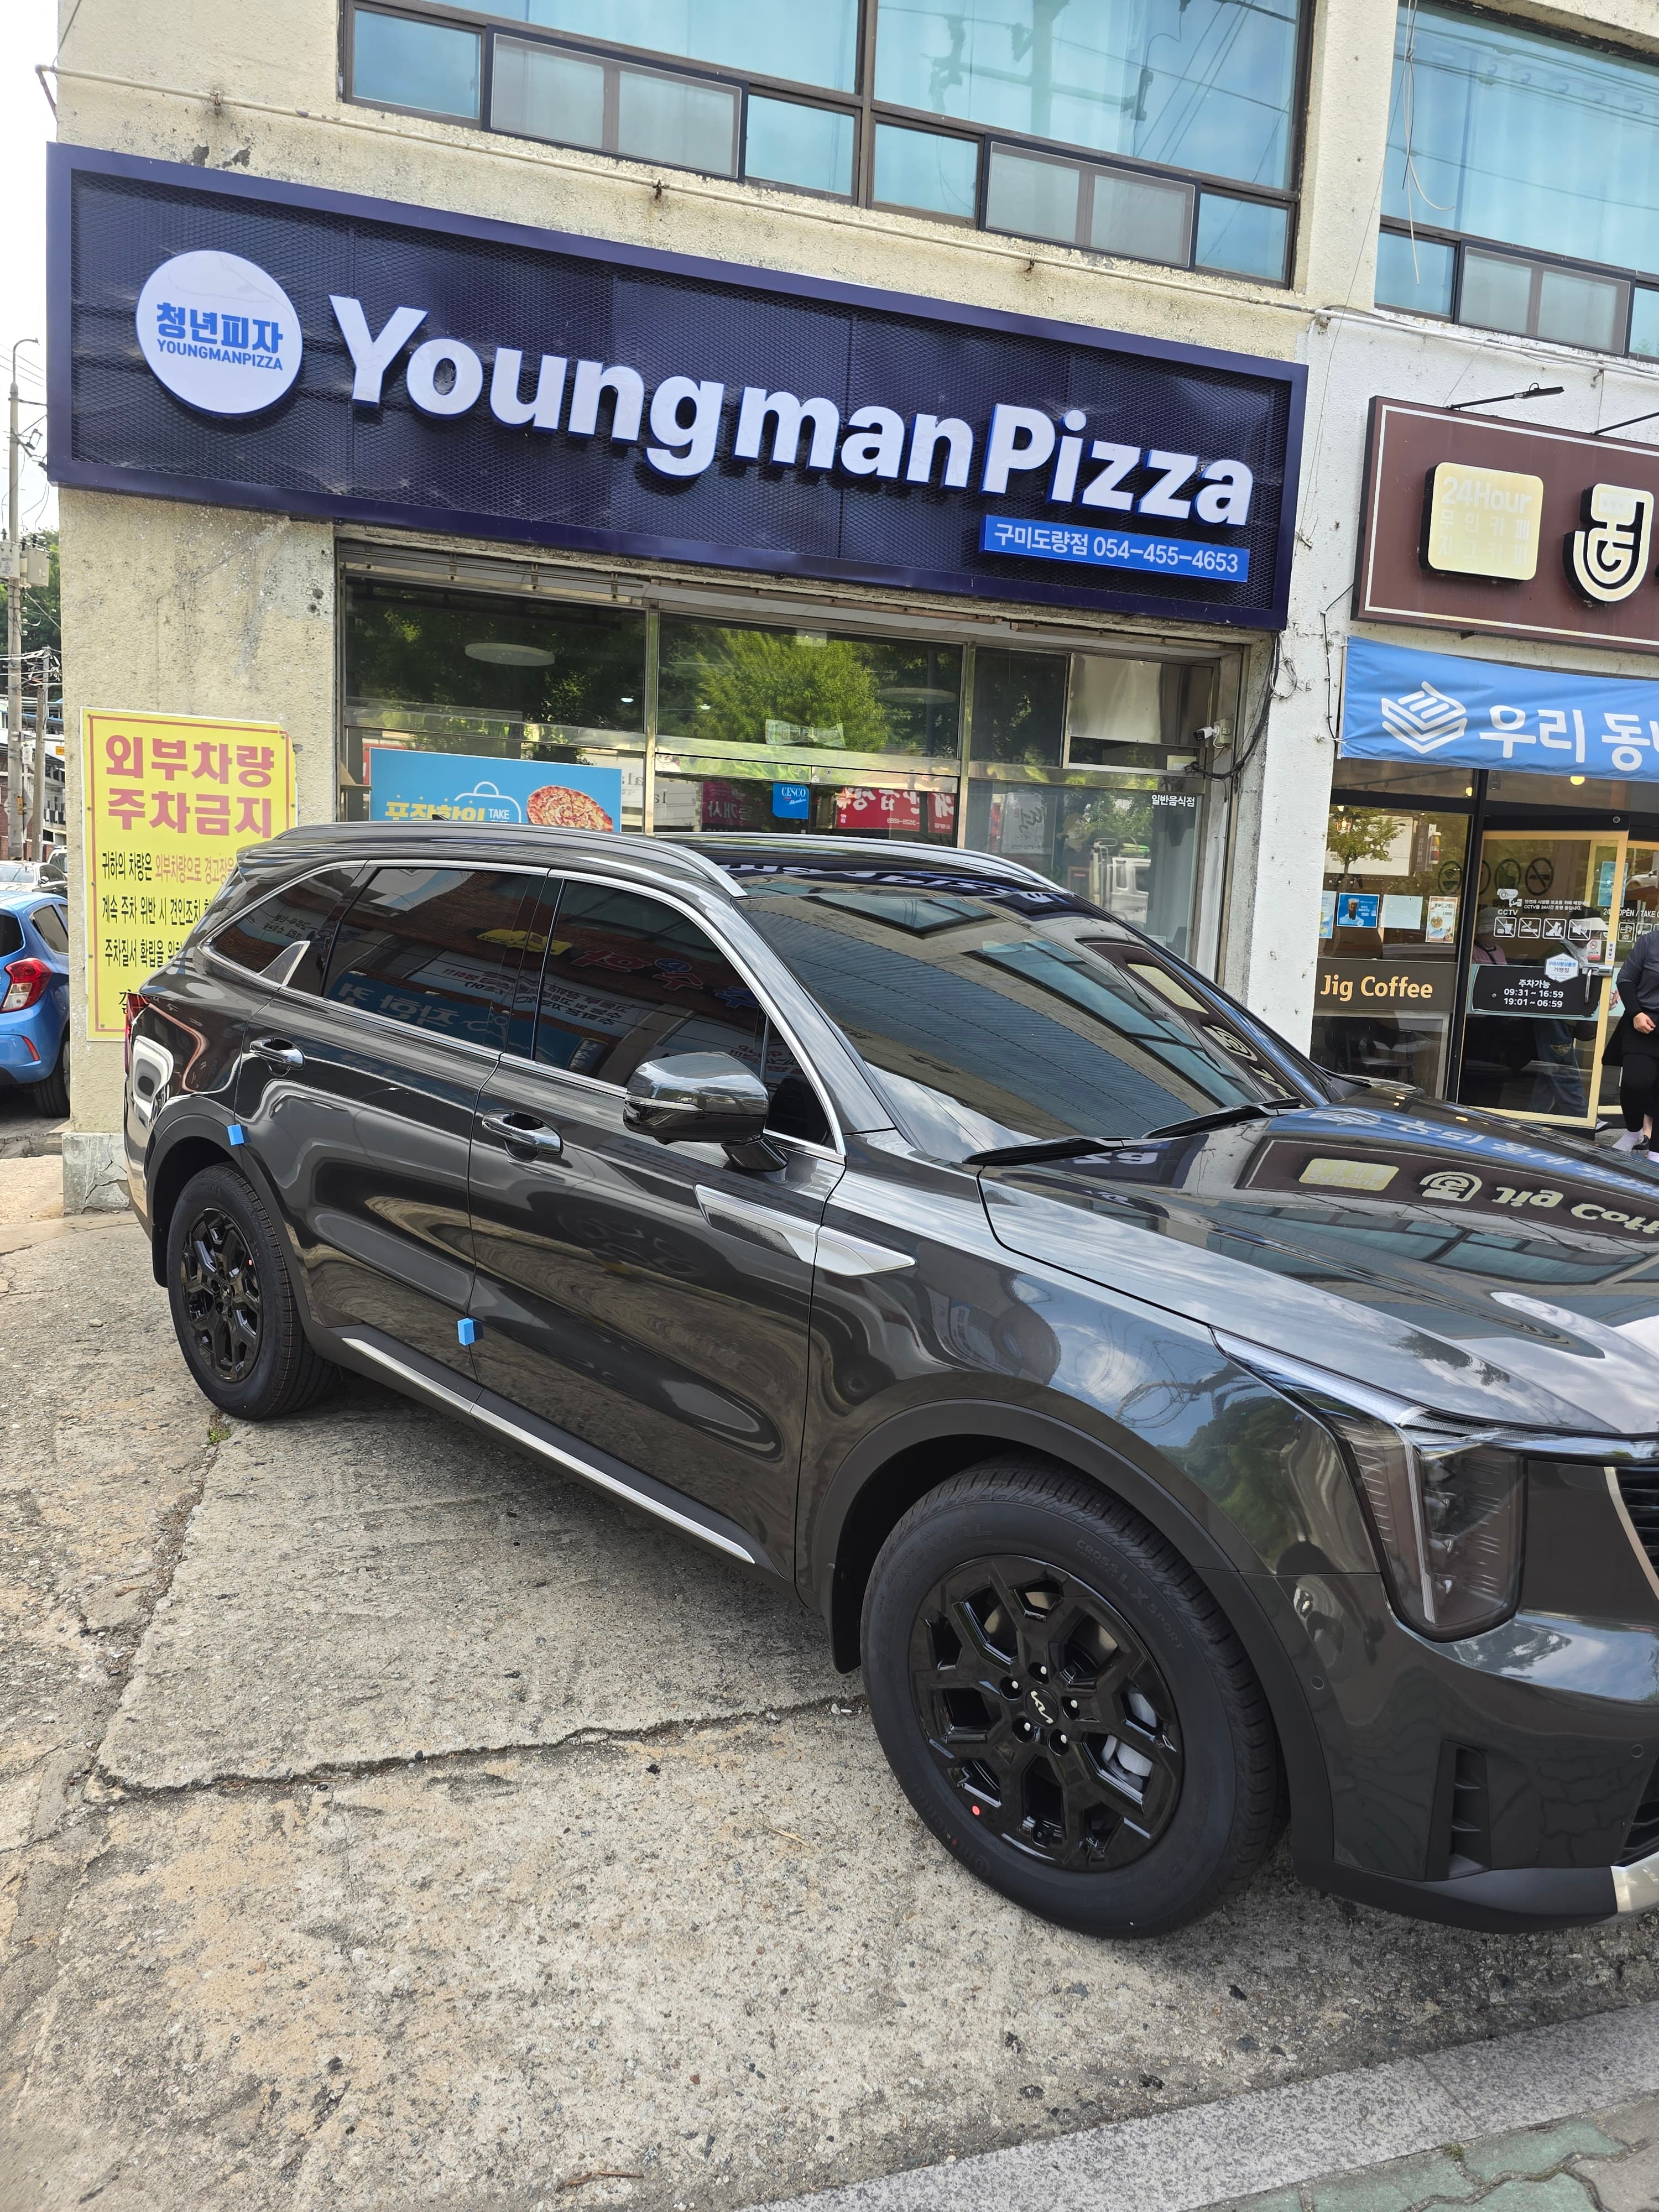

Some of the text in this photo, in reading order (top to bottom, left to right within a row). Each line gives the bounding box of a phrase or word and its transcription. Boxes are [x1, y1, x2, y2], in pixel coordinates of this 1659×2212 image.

[157, 302, 283, 354] 청년피자
[157, 338, 283, 371] YOUNGMANPIZZA
[994, 523, 1238, 573] 구미도량점 054-455-4653
[1479, 705, 1585, 763] 우리
[106, 734, 275, 788] 외부차량
[781, 787, 806, 797] CESCO
[1151, 794, 1194, 807] 일반음식점
[107, 787, 272, 838] 주차금지
[488, 808, 509, 820] TAKE
[102, 851, 126, 880] 귀하의
[129, 852, 152, 881] 차량은
[155, 854, 202, 884] 외부차량으로
[102, 894, 118, 925] 계속
[121, 896, 137, 925] 주차
[140, 896, 155, 925] 위반
[159, 897, 166, 926] 시
[170, 898, 201, 926] 견인조치
[105, 938, 137, 968] 주차질서
[1321, 974, 1433, 1002] Jig Coffee
[1519, 979, 1550, 988] 주차가능
[1539, 990, 1563, 998] 16:59
[1537, 999, 1563, 1008] 06:59
